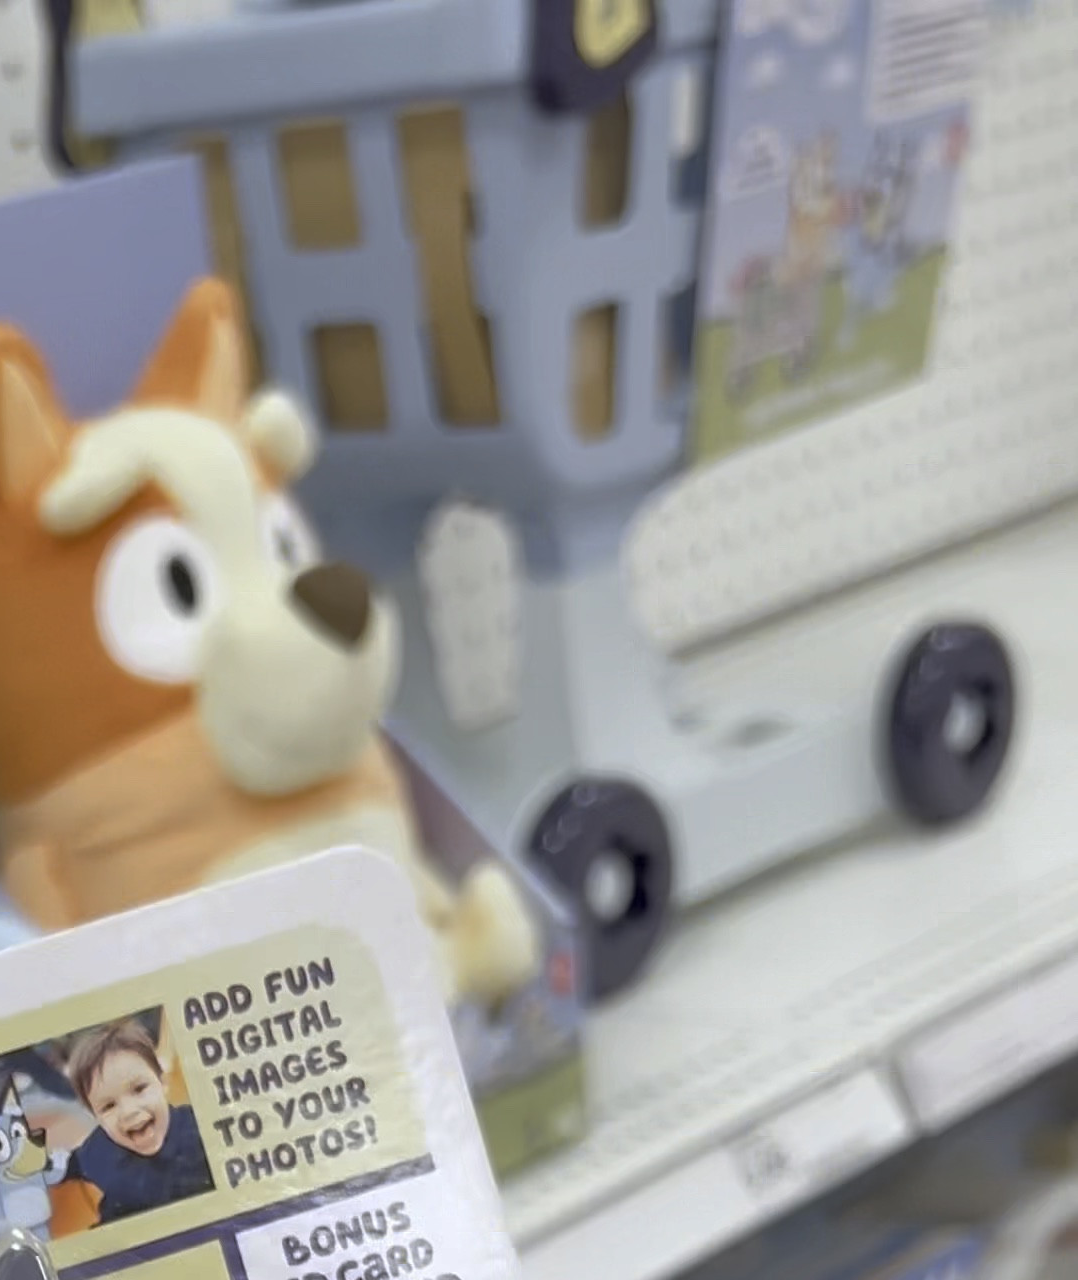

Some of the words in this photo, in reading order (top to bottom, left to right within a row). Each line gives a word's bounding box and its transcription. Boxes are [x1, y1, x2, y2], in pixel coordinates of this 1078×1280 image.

[184, 984, 252, 1029] ADD
[263, 957, 335, 1003] FUN
[197, 1000, 342, 1067] DIGITAL
[212, 1040, 347, 1106] IMAGES
[213, 1111, 263, 1147] TO
[273, 1077, 371, 1129] YOUR
[225, 1115, 378, 1188] PHOTOS!
[282, 1202, 411, 1266] BONUS
